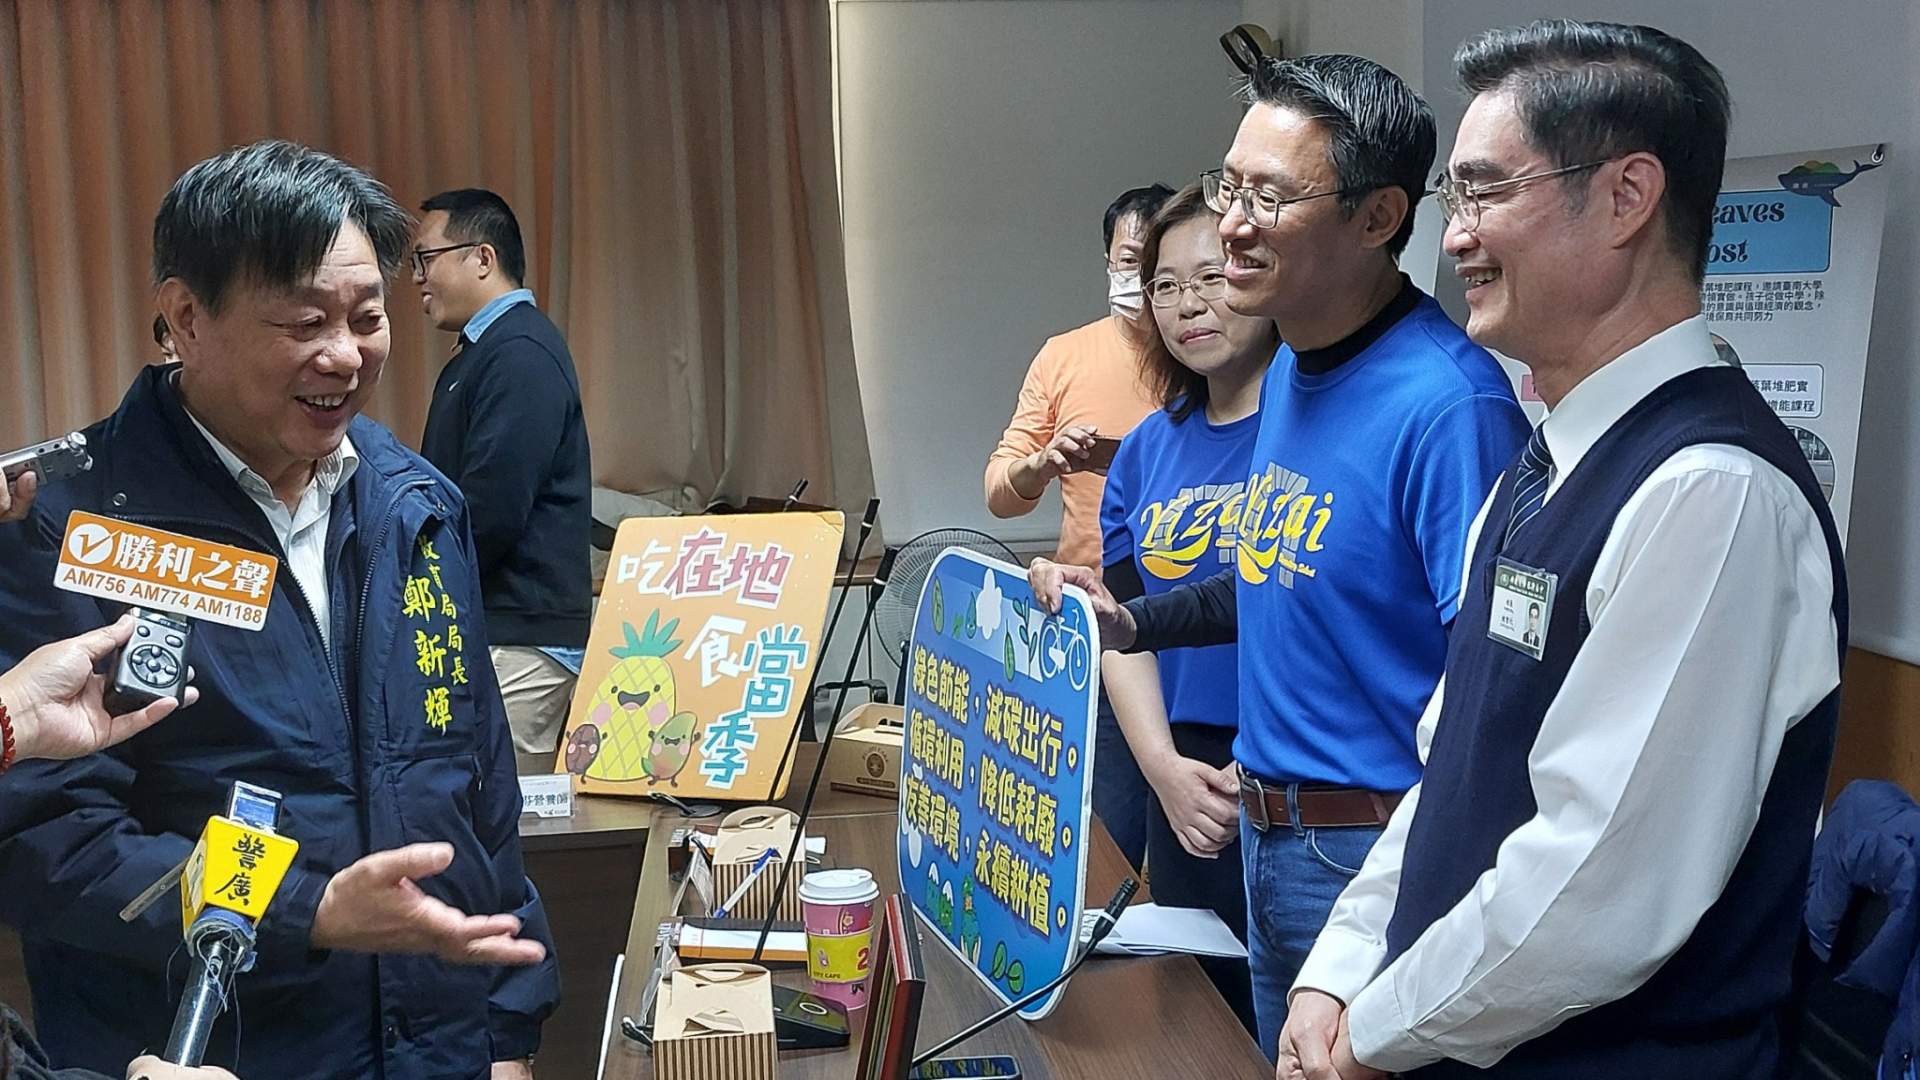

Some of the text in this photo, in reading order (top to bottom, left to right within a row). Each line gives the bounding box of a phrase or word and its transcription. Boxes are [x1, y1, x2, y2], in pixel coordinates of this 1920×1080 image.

[63, 567, 263, 624] AM756 AM774 AM1188
[112, 531, 271, 599] 勝利之聲
[617, 527, 793, 610] 吃在地
[402, 575, 453, 736] 鄭新輝
[215, 833, 266, 906] 警廣
